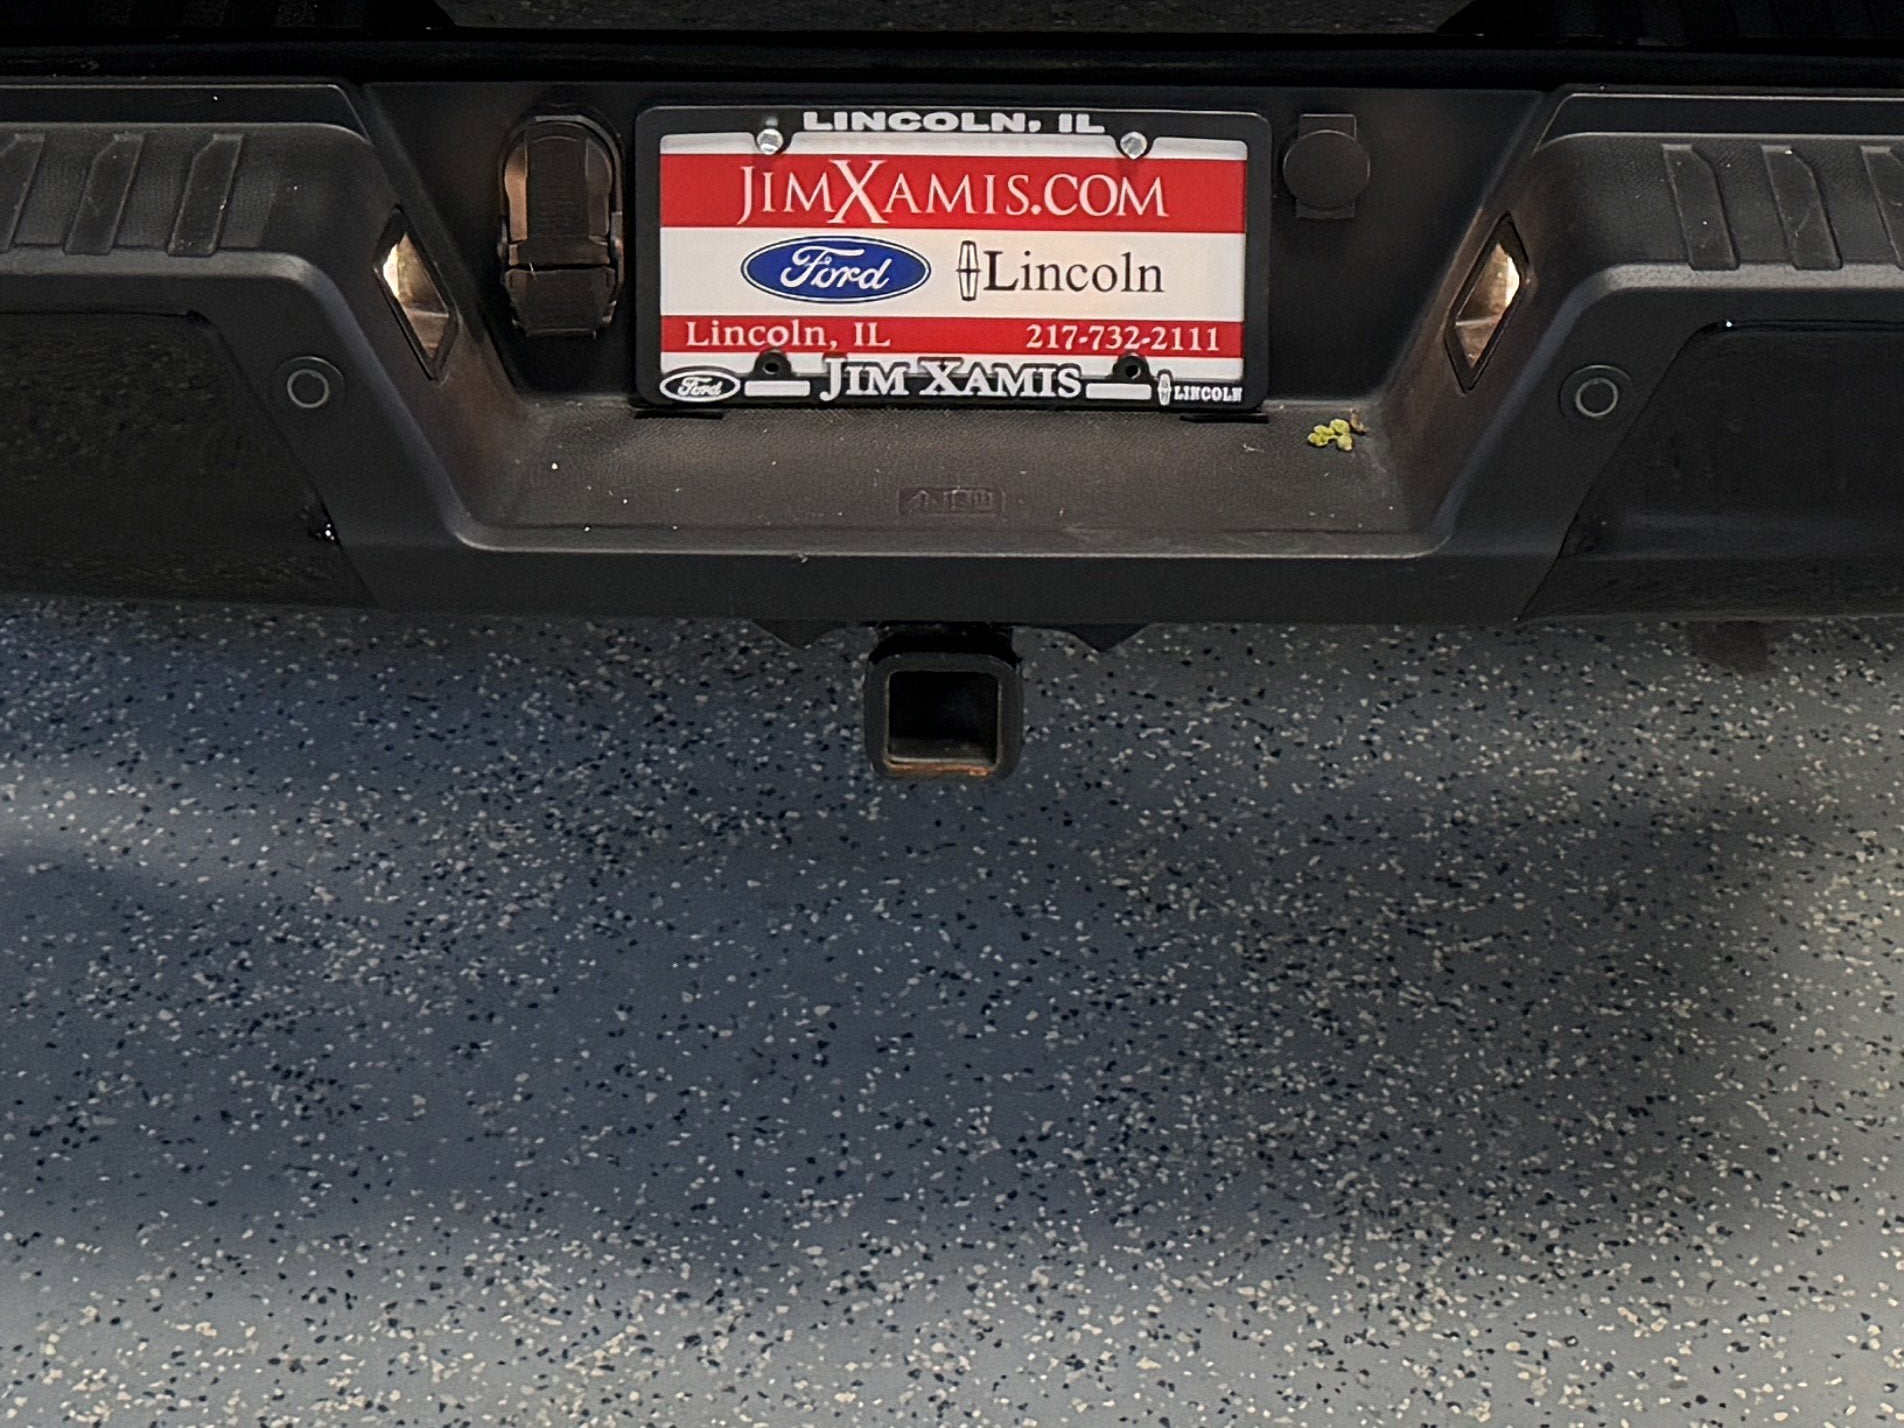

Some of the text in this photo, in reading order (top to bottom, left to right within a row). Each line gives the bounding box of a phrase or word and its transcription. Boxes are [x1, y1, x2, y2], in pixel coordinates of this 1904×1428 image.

[803, 110, 1106, 134] LINCOLN, IL
[737, 158, 1171, 225] JIMXAMIS.COM
[780, 247, 1164, 294] Ford Lincoln
[685, 319, 892, 350] Lincoln, IL
[1025, 323, 1221, 353] 217-732-2111
[677, 357, 1244, 403] Ford JIM XAMIS LINCOLN
